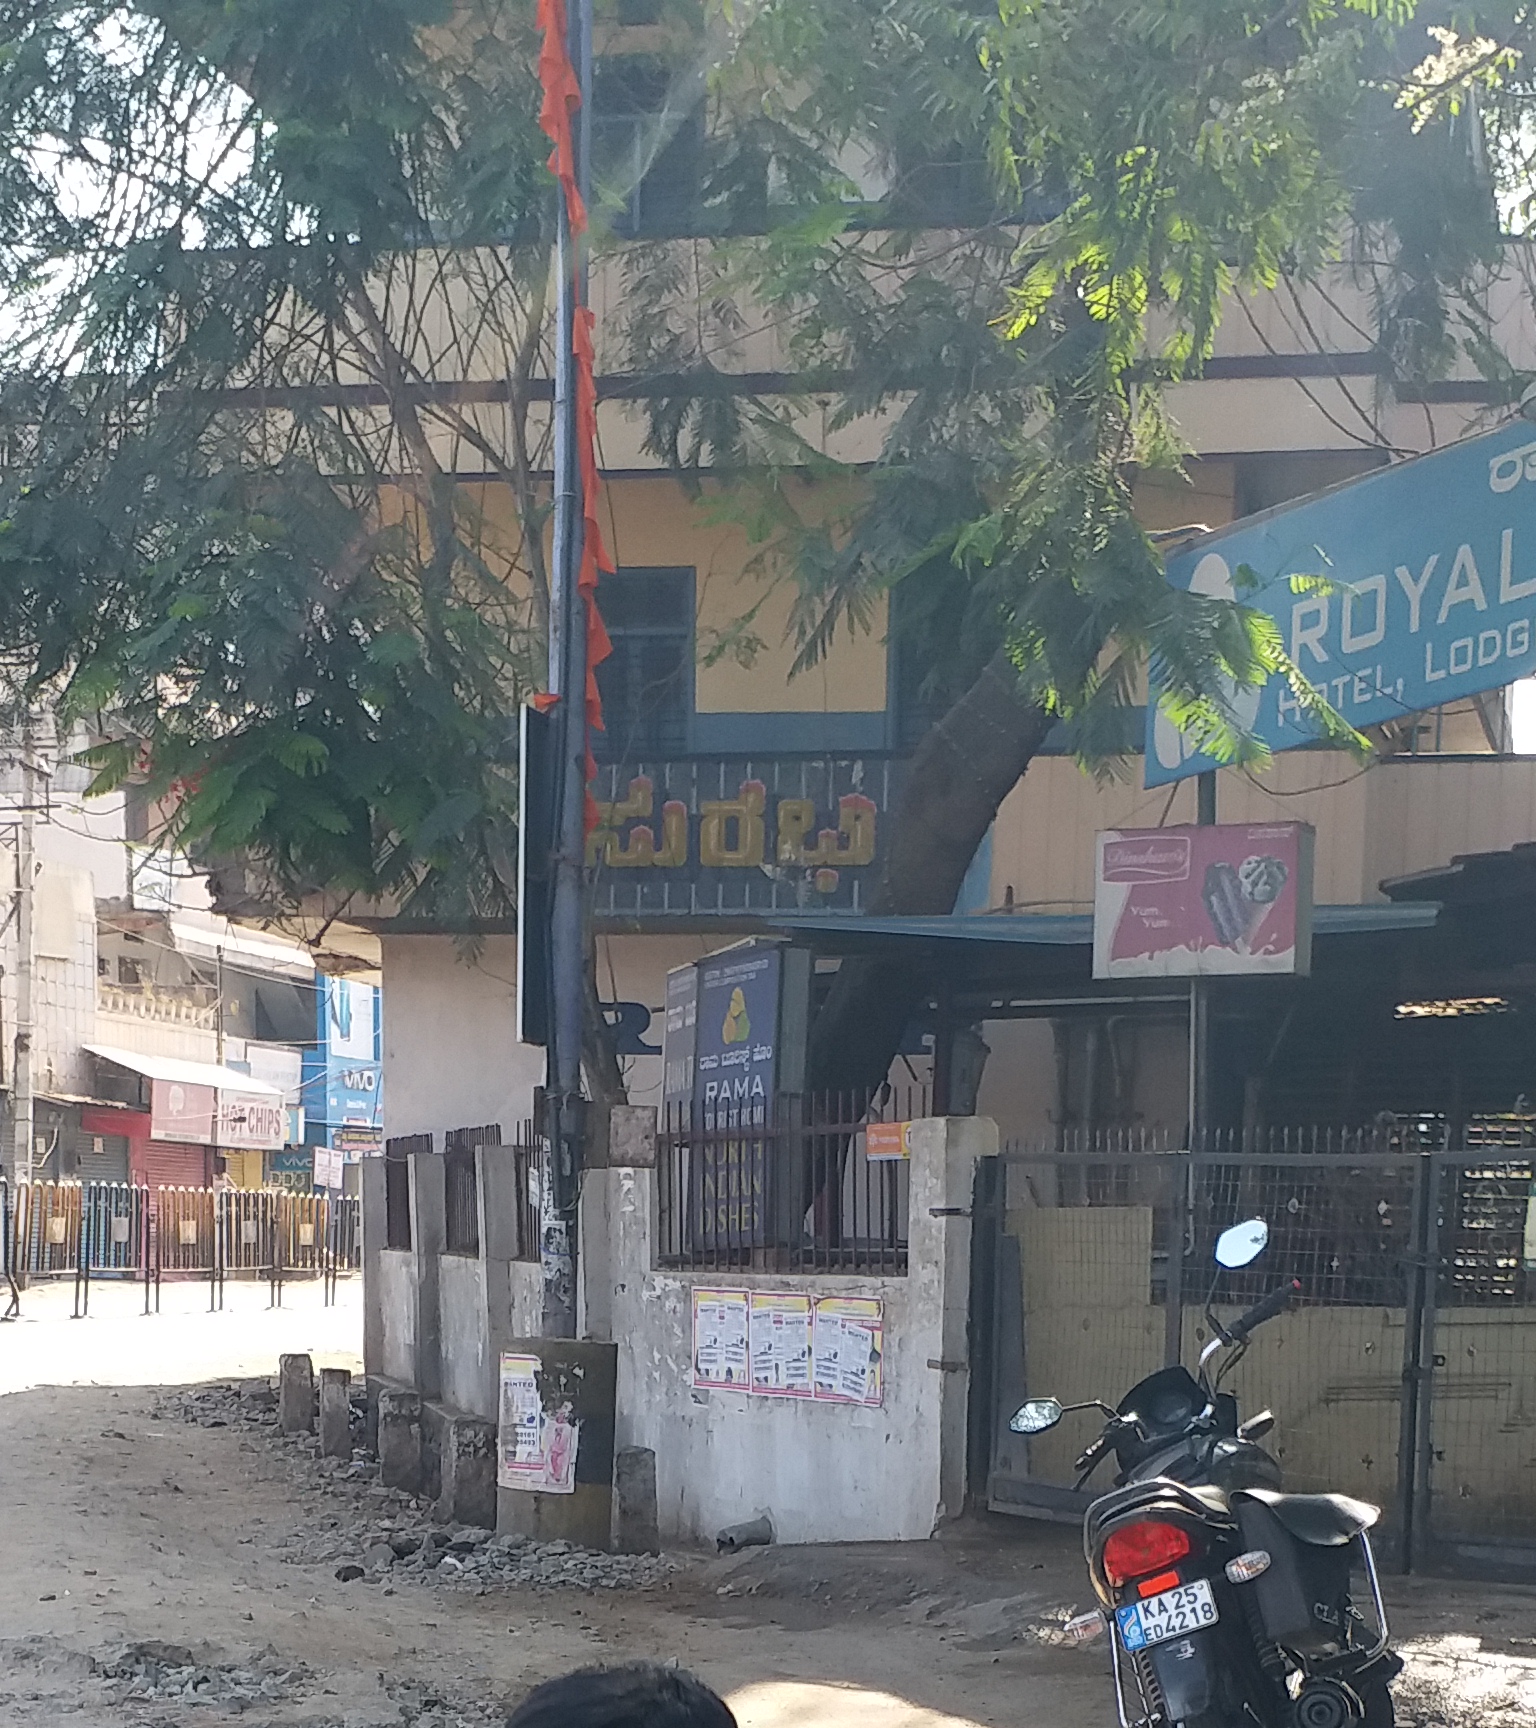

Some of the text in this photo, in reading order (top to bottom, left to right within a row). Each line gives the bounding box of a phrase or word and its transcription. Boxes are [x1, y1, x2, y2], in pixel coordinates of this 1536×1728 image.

[705, 1074, 765, 1106] RAMA
[248, 1106, 282, 1137] CHIPS
[700, 1202, 759, 1235] DSHES
[1141, 1585, 1199, 1622] KA 25
